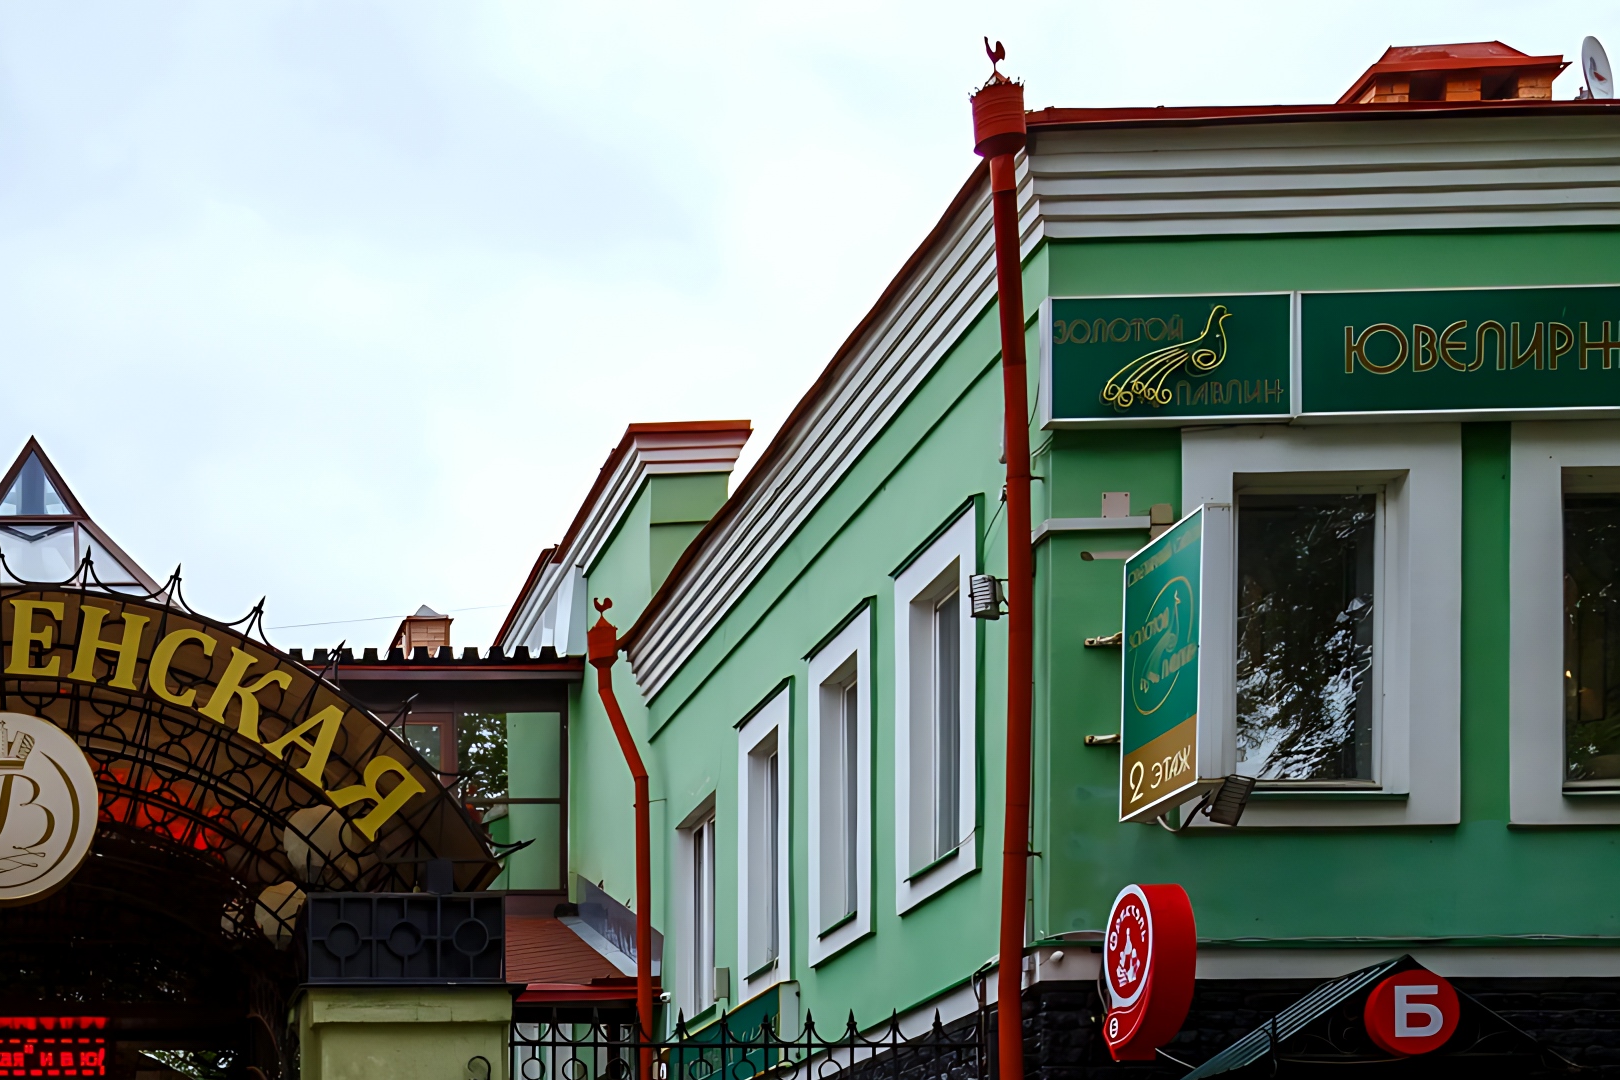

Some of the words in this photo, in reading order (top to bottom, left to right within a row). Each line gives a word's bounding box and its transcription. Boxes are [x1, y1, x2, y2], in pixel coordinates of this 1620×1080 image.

[1054, 315, 1183, 344] ЗОЛОТОЙ
[1344, 319, 1620, 375] ЮВЕЛИРН
[1175, 378, 1283, 406] ПАВЛИН
[1130, 760, 1144, 804] 2
[1394, 985, 1443, 1037] Б
[39, 1052, 53, 1067] и
[60, 1052, 74, 1067] в
